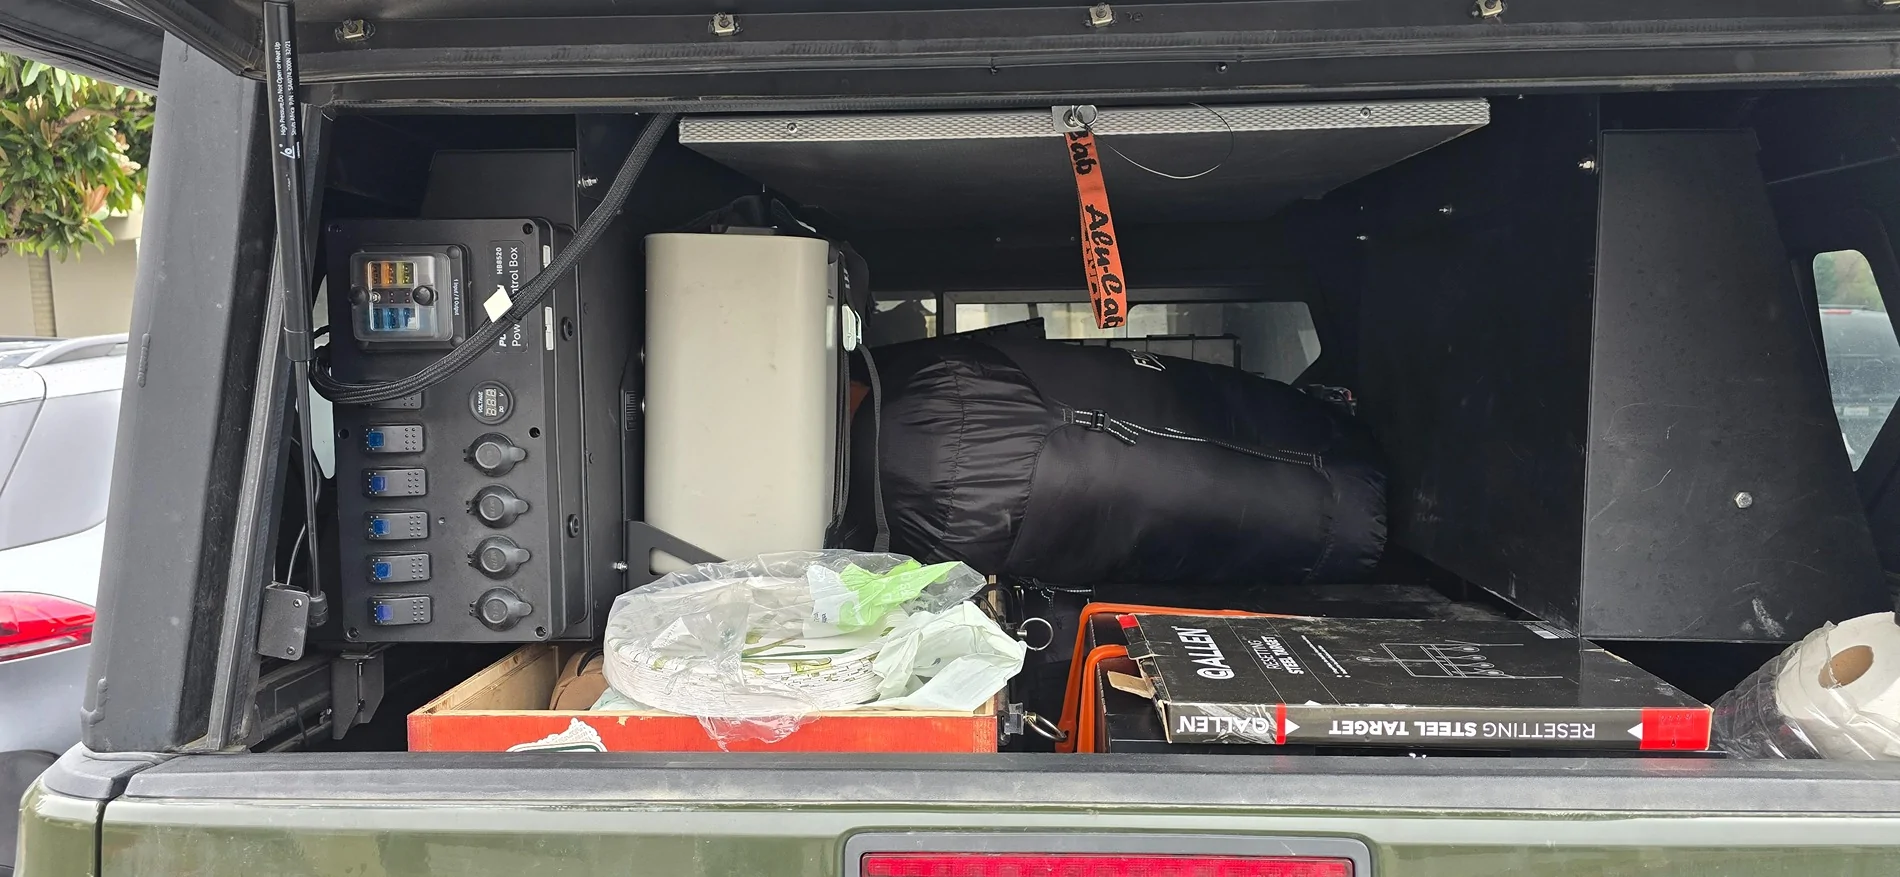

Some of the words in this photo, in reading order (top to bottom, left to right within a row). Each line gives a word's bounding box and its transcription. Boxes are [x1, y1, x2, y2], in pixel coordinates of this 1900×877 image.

[274, 41, 281, 50] Up
[509, 247, 518, 267] Box
[512, 323, 521, 347] Pow
[1247, 640, 1282, 669] RESETTING
[1261, 635, 1290, 656] TARGET
[1279, 656, 1304, 674] STEEL
[1328, 720, 1410, 735] TARGET
[1414, 721, 1478, 737] STEEL
[1483, 723, 1596, 738] RESETTING
